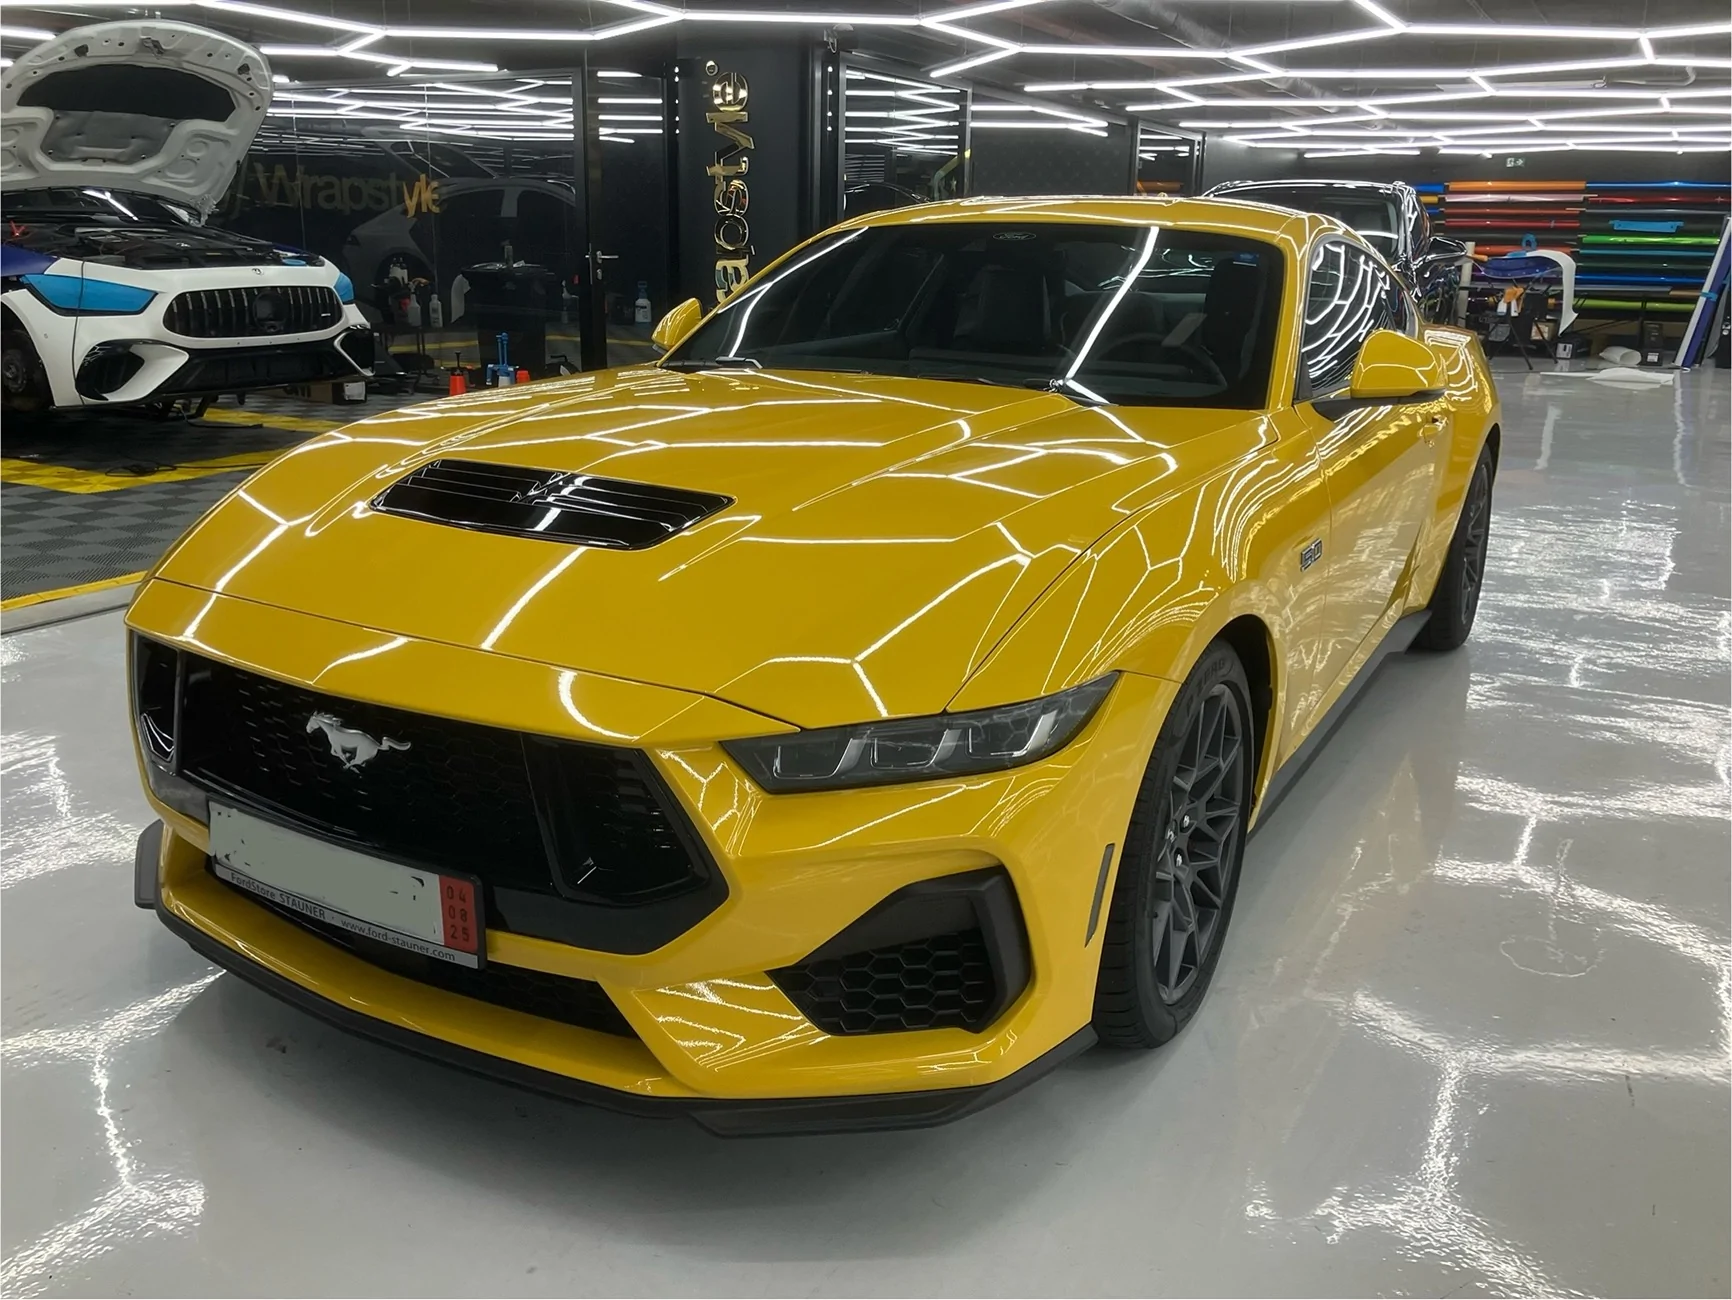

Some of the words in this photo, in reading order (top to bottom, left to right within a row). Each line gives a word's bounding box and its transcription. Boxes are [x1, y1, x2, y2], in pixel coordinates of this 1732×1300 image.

[230, 872, 276, 900] FordStore
[279, 893, 326, 920] STAUNER
[340, 919, 456, 961] www.ford-stauner.com
